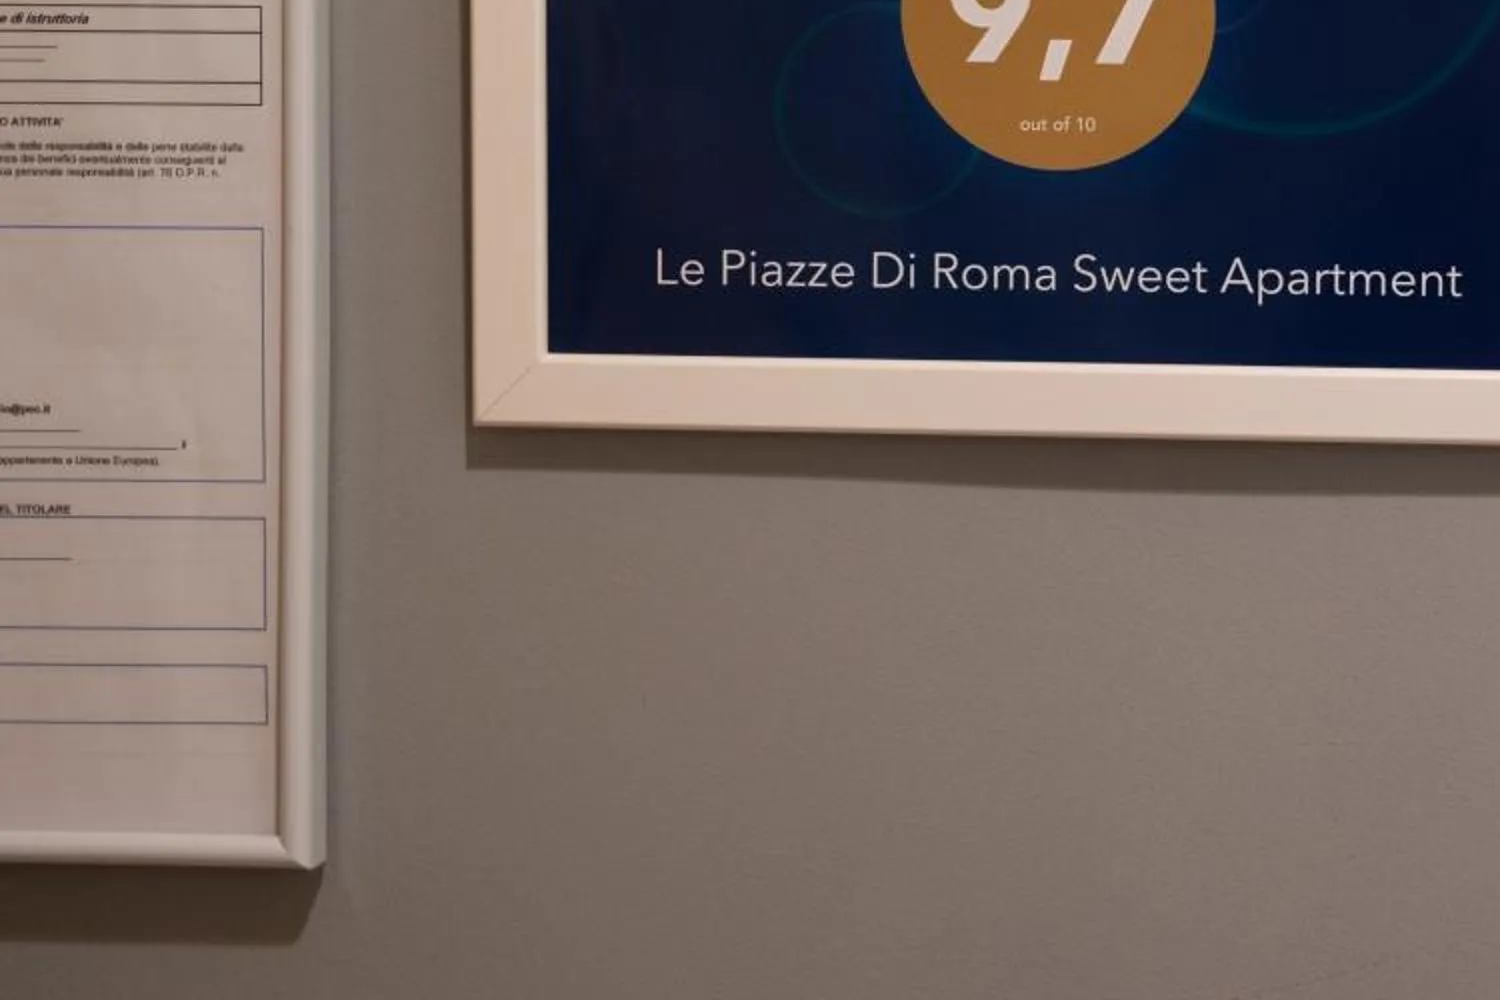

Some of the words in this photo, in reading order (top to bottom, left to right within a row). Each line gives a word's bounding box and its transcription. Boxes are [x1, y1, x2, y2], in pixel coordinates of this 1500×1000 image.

[26, 11, 89, 24] istruttoria
[1020, 118, 1048, 132] out
[1052, 117, 1071, 132] of
[1078, 117, 1097, 132] 10
[654, 247, 705, 287] Le
[721, 250, 856, 289] Piazze
[871, 252, 916, 290] Di
[933, 253, 1058, 292] Roma
[1072, 254, 1208, 294] Sweet
[1220, 256, 1463, 306] Apartment
